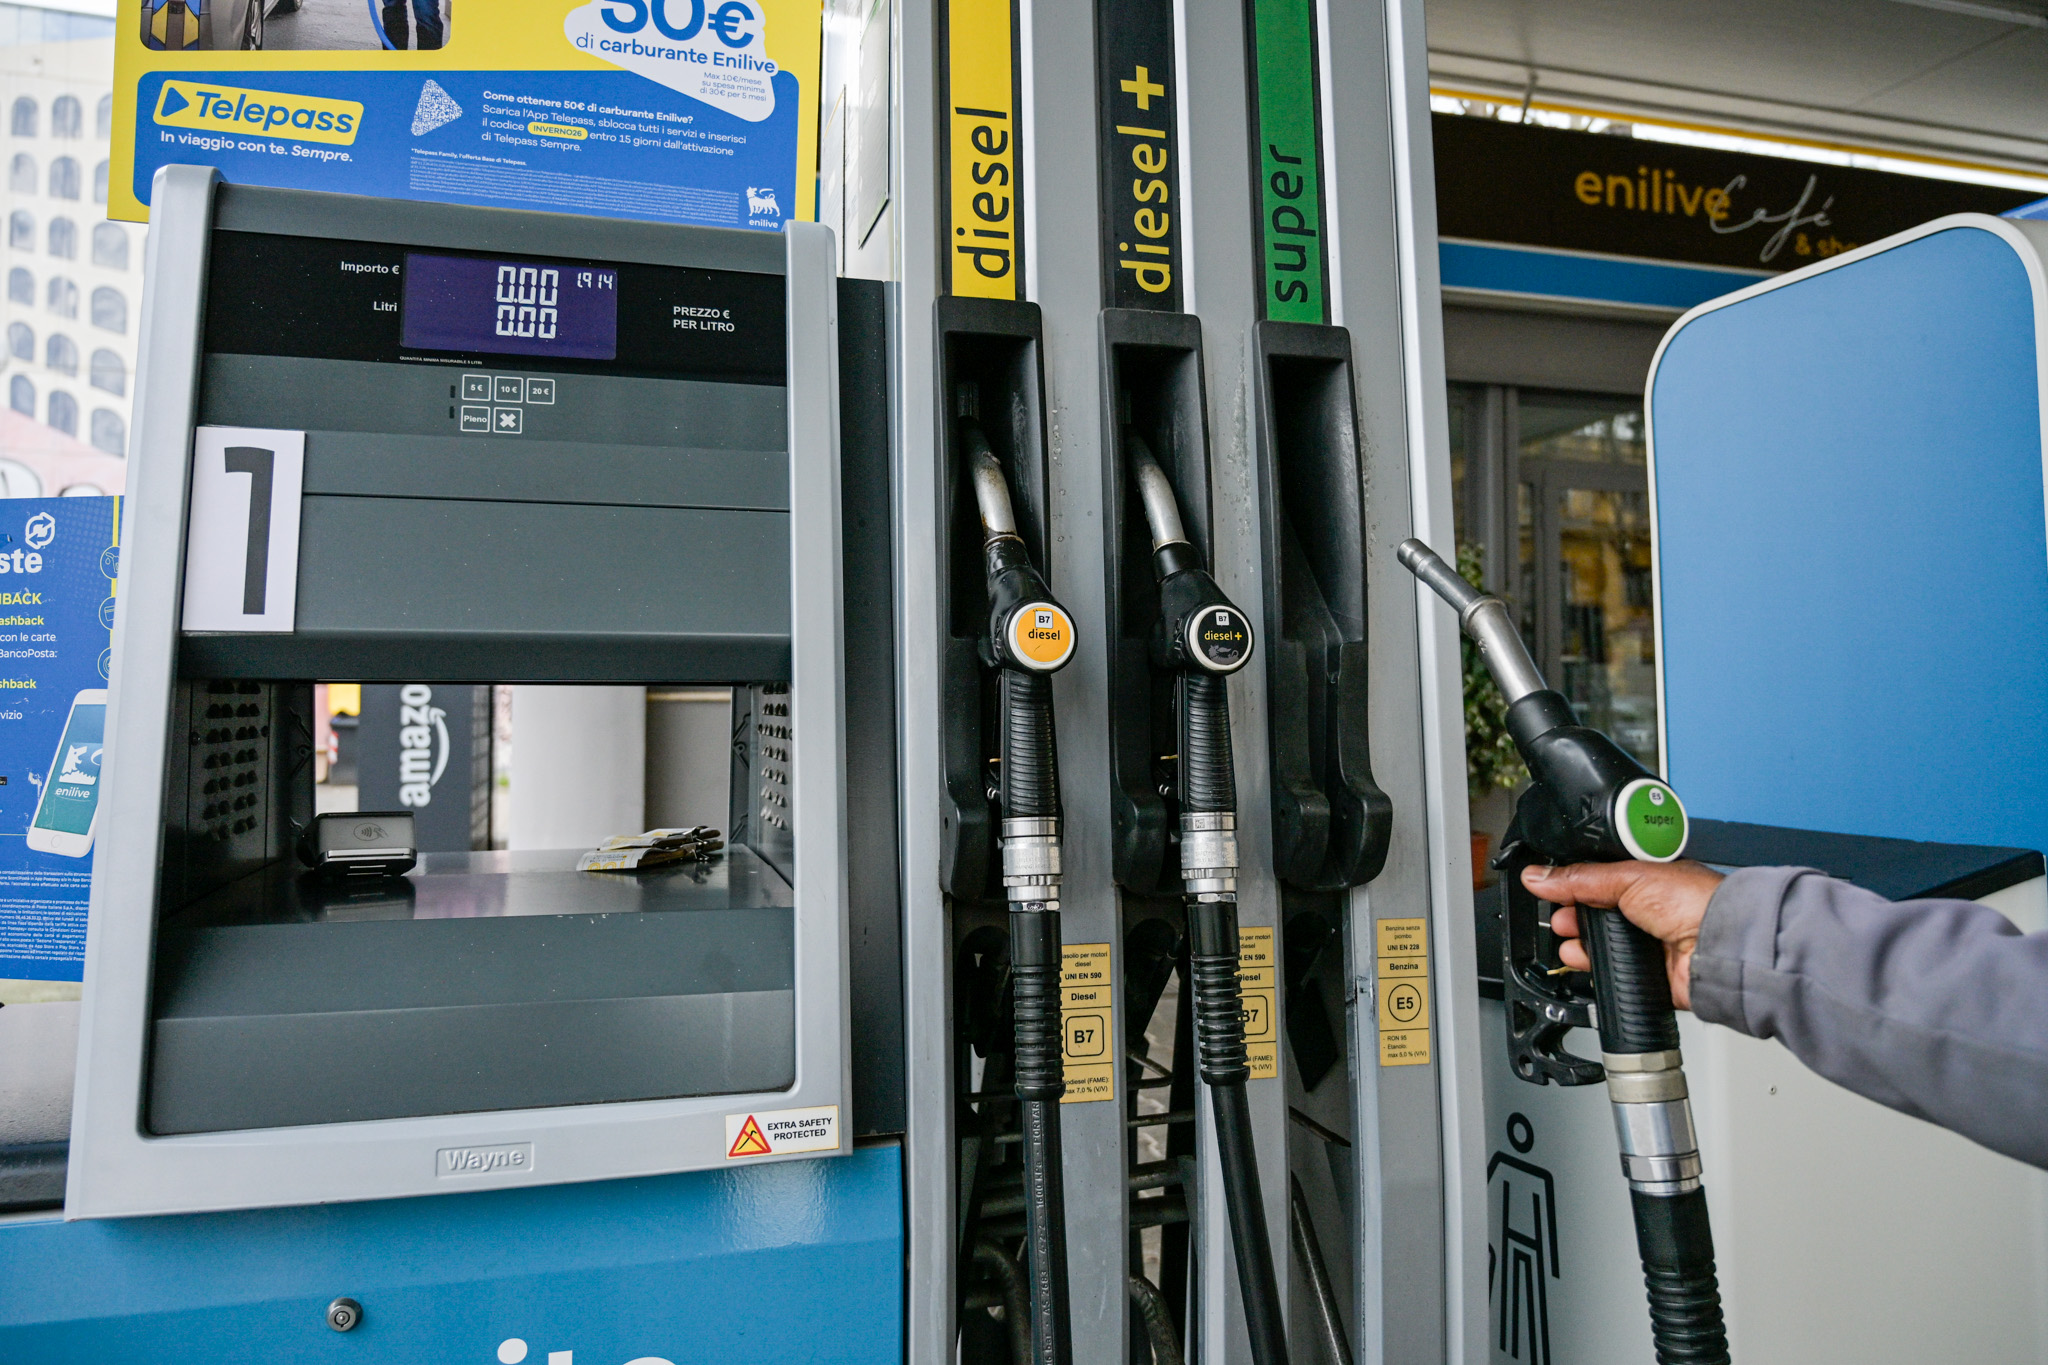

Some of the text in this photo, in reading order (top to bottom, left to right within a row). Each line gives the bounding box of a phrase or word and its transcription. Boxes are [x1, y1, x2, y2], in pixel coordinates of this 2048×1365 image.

[576, 32, 775, 73] di carburante Enilive
[704, 72, 762, 85] Max 10€/mese
[709, 88, 726, 96] 30€
[712, 81, 735, 90] spesa
[736, 84, 766, 94] minima
[196, 91, 354, 134] Telepass
[483, 91, 693, 124] Come ottenere 50€ di carburante Enilive?
[482, 104, 521, 117] Scarica
[522, 108, 549, 121] l'App
[551, 112, 596, 127] Telepass,
[598, 117, 636, 131] sblocca
[638, 123, 660, 134] tutti
[666, 127, 698, 138] servizi
[708, 131, 747, 144] inserisci
[481, 131, 582, 152] di Telepass Sempre.
[482, 117, 734, 156] il codice INVERNO26 entro 15 giorni dall'attivazione
[161, 131, 353, 162] In viaggio con te. Sempre.
[954, 106, 1011, 279] diesel
[1574, 166, 1732, 220] enilive
[749, 219, 778, 228] enilive
[1268, 144, 1317, 303] super
[341, 261, 400, 275] Importo €
[496, 266, 559, 306] 0.00
[373, 301, 397, 312] Litri
[673, 306, 730, 319] PREZZO €
[496, 304, 558, 339] 0.00
[673, 319, 735, 332] PER LITRO
[463, 415, 487, 423] Pieno
[224, 446, 275, 615] 1
[0, 593, 42, 605] BACK
[1038, 615, 1050, 624] B7
[1218, 615, 1227, 623] B7
[0, 632, 56, 642] con le carte
[1028, 629, 1060, 641] diesel
[55, 786, 90, 799] enilive
[1643, 814, 1674, 827] super
[1390, 962, 1419, 970] Benzina
[1071, 992, 1097, 1001] Diesel
[1396, 997, 1414, 1010] E5
[1074, 1029, 1094, 1044] B7
[767, 1117, 832, 1131] EXTRA SAFETY
[774, 1128, 827, 1141] PROTECTED
[446, 1149, 524, 1172] Wayne
